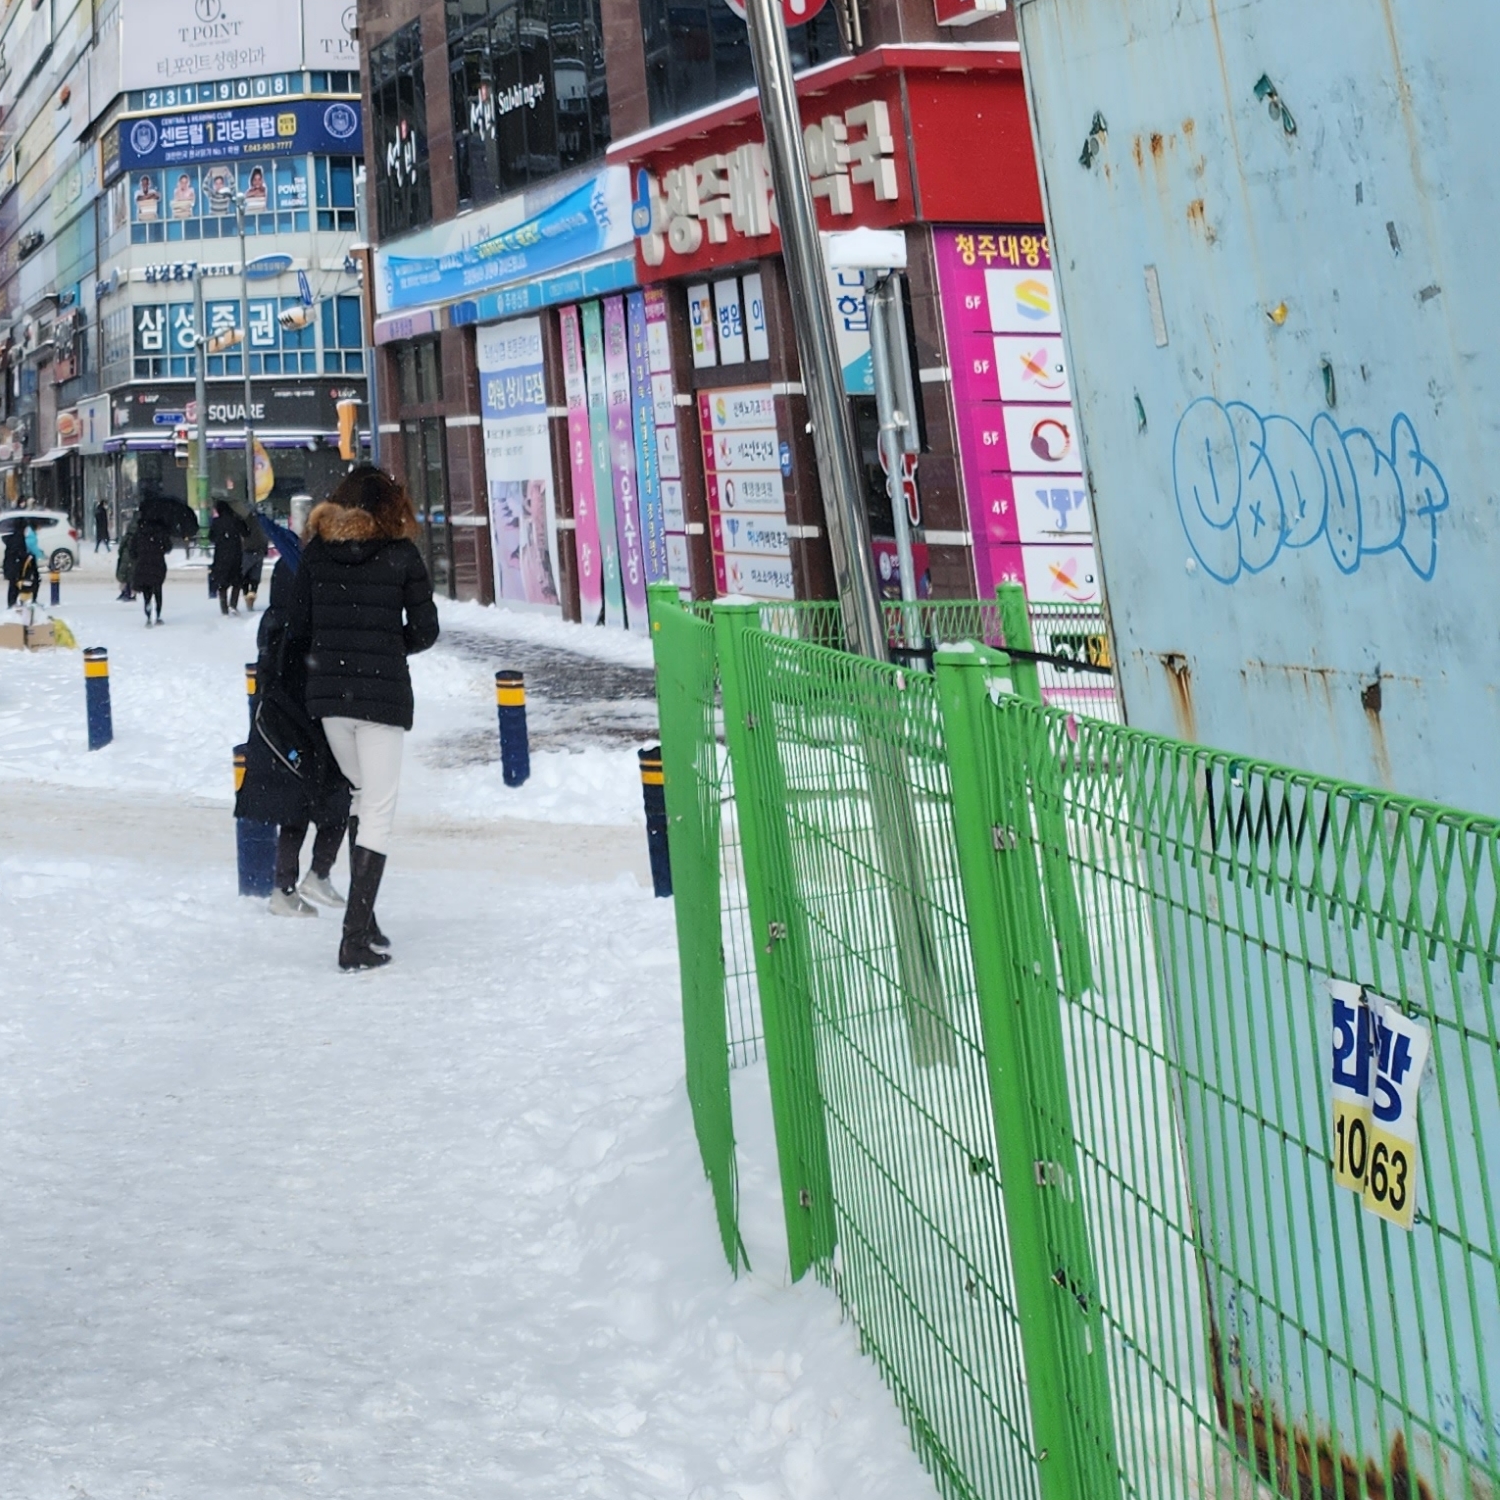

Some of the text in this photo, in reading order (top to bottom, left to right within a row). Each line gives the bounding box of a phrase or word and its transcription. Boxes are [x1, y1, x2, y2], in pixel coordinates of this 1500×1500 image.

[193, 20, 243, 41] POINT
[148, 79, 285, 107] 231-9008
[664, 100, 898, 255] 청주대약국
[278, 184, 307, 195] POWER
[965, 296, 981, 310] 5F
[974, 360, 990, 375] 5F
[208, 403, 265, 422] SQUARE
[983, 432, 999, 446] 5F
